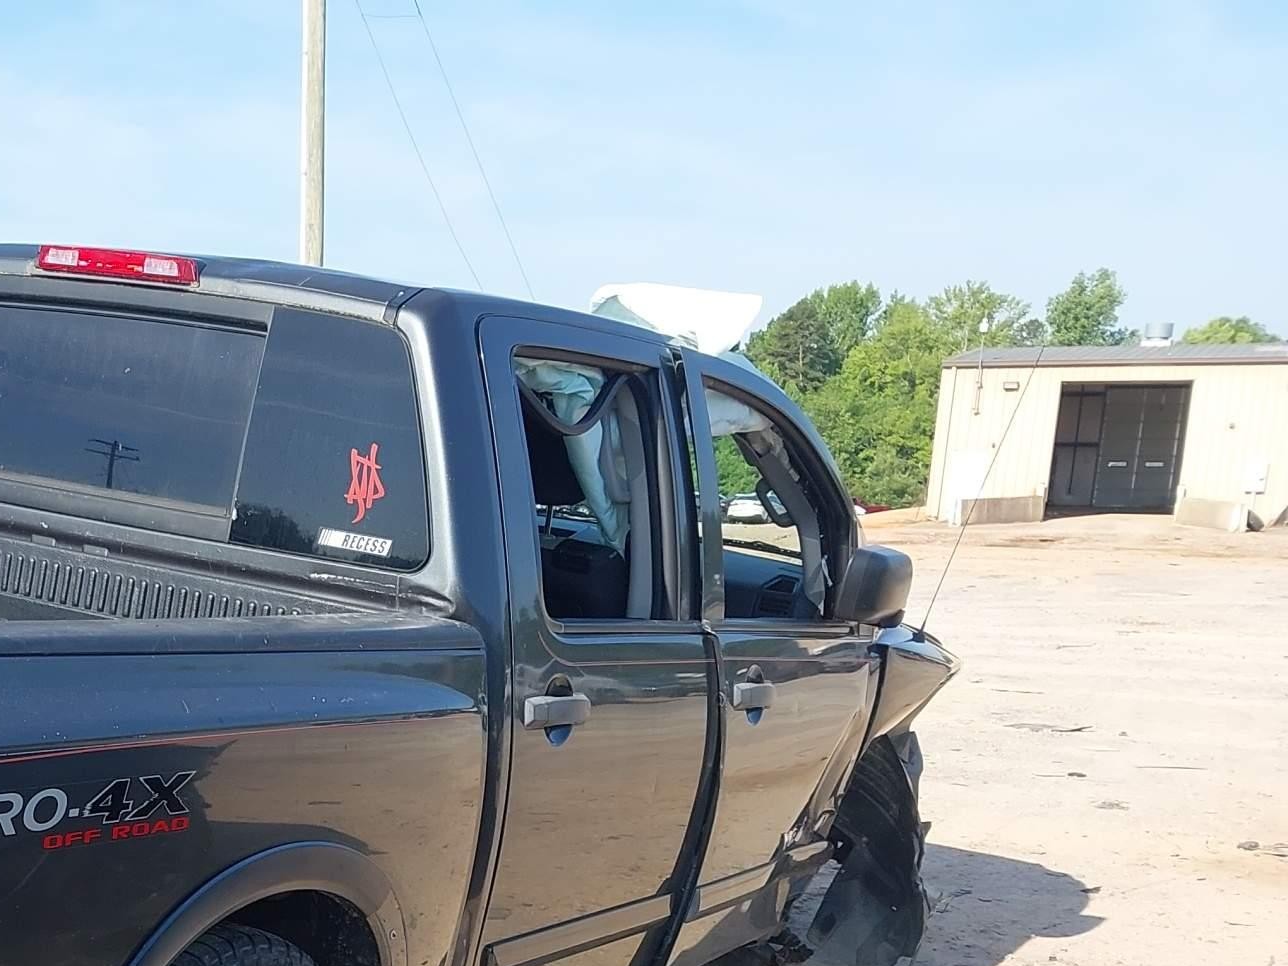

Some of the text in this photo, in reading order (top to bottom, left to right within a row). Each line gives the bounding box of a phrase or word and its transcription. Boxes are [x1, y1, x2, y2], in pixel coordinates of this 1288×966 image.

[341, 533, 388, 555] RECESS
[42, 816, 190, 849] OFF ROAD
